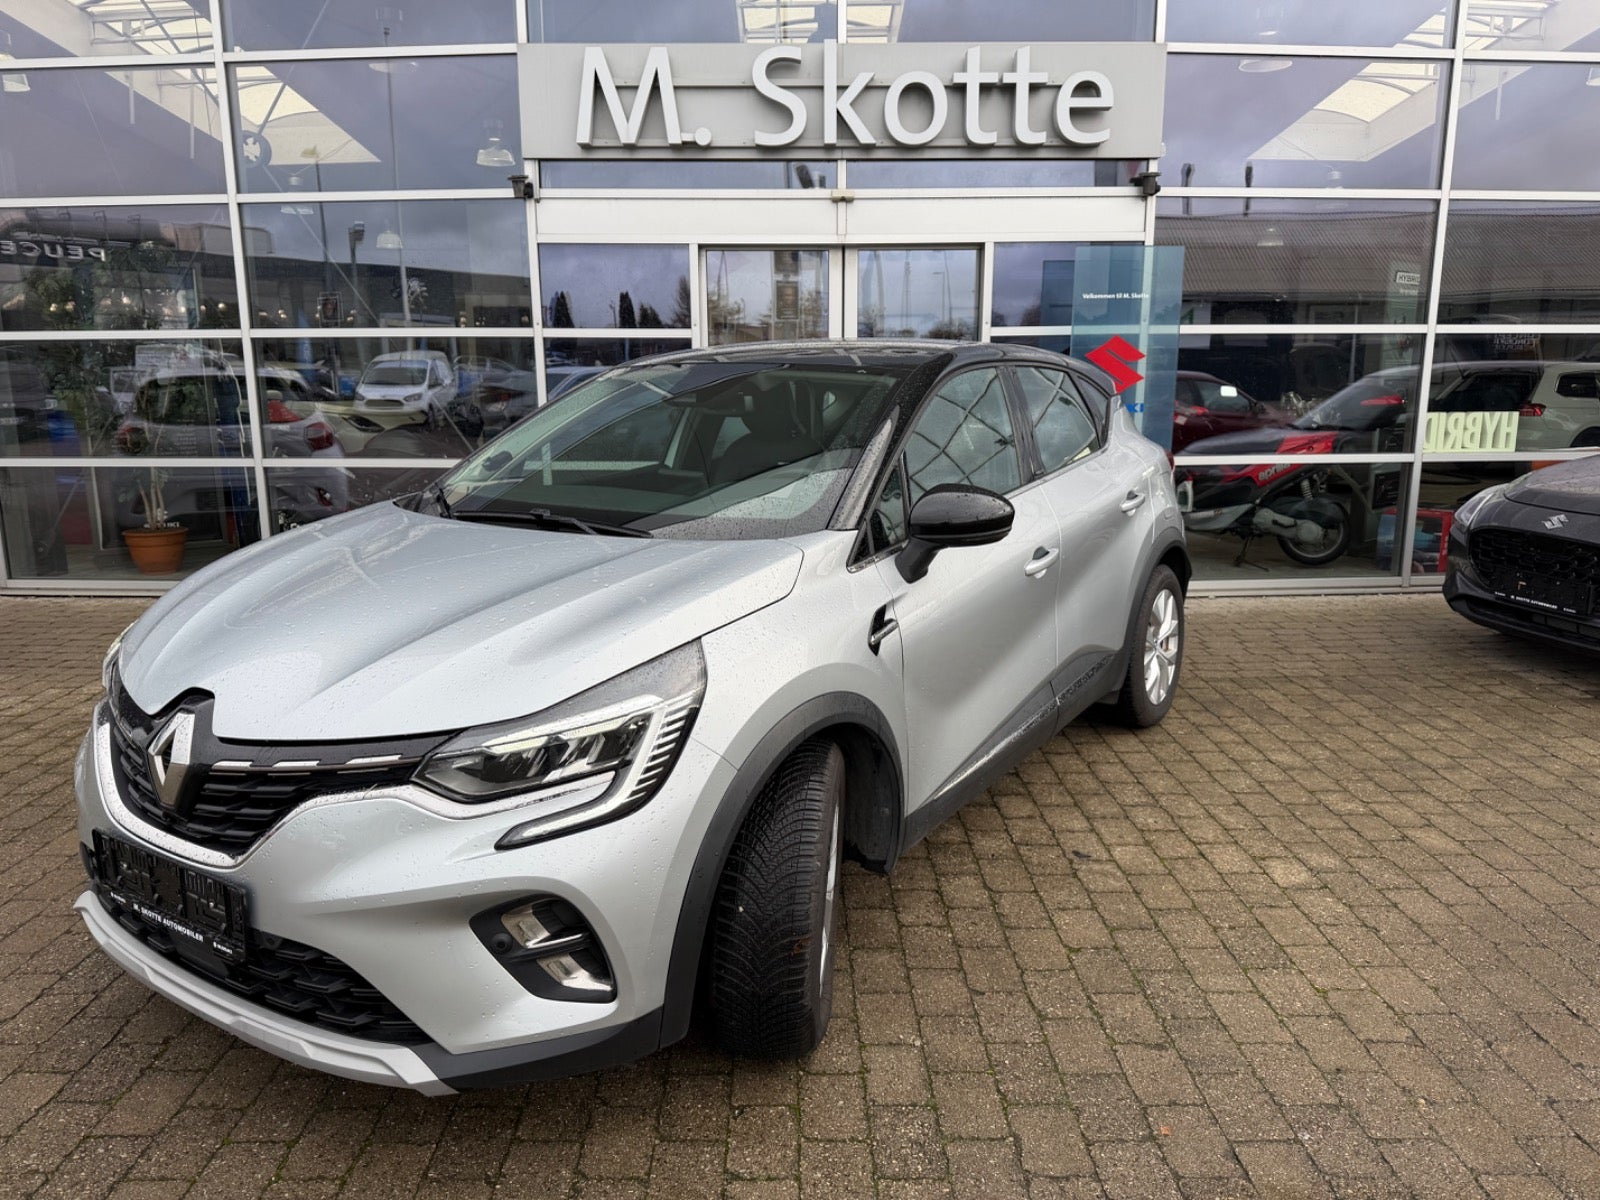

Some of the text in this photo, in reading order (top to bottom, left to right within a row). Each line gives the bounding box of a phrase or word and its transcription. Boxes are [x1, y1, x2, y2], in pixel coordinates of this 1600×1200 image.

[576, 38, 1115, 149] M. Skotte
[141, 907, 162, 923] SKOTTE
[162, 918, 204, 942] AUTOMOBILER
